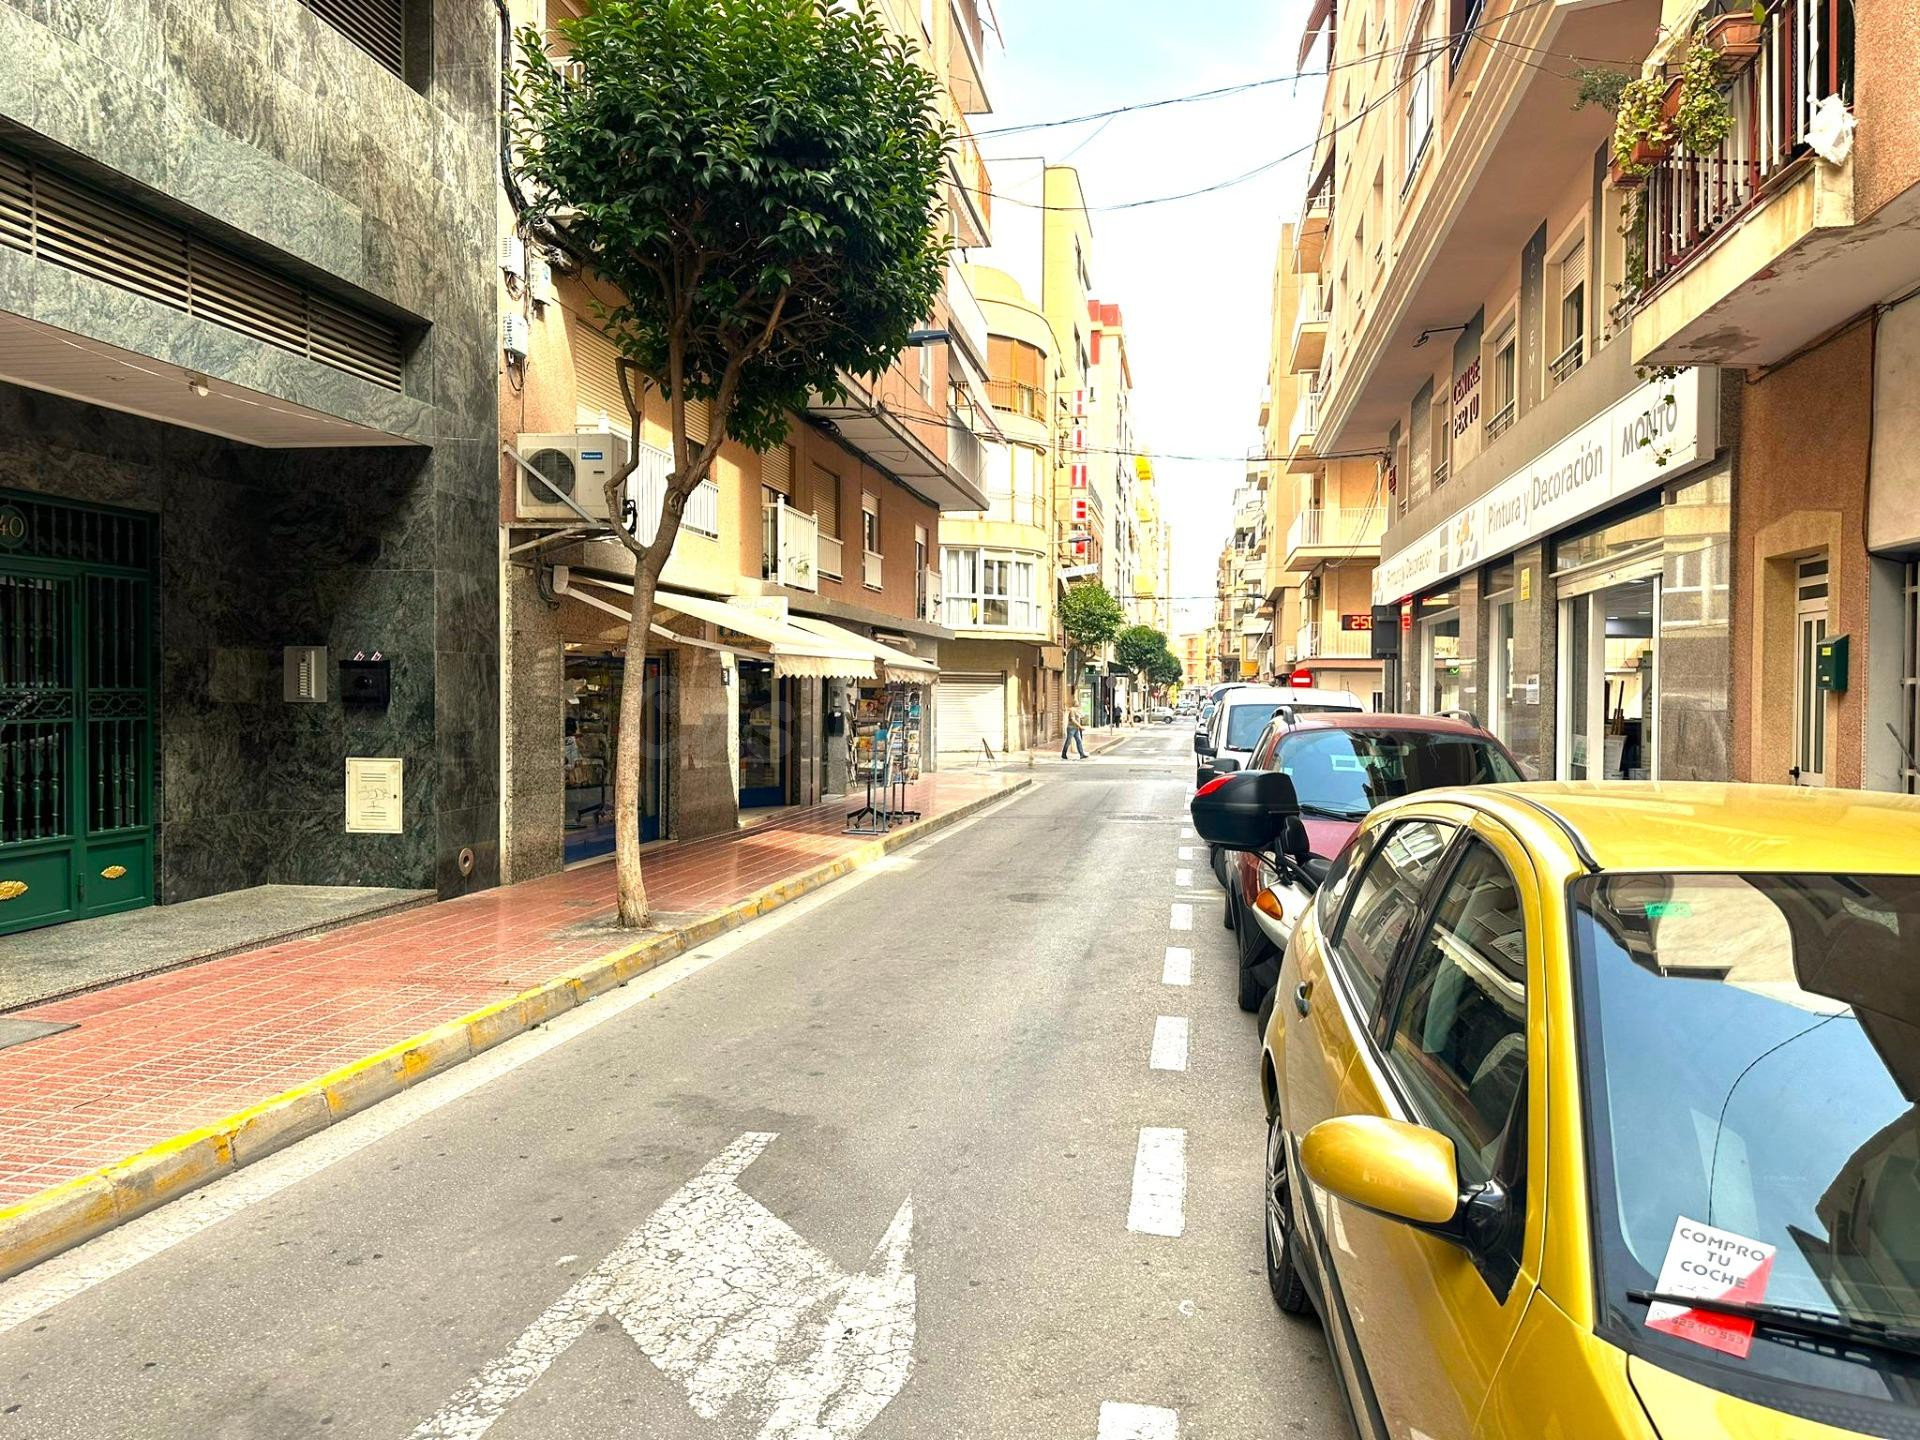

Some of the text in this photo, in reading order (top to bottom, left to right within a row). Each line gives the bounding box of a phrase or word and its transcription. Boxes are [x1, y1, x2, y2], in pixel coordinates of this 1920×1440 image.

[1528, 241, 1536, 408] ACADEMIA
[1488, 495, 1521, 535] Pintura
[1521, 489, 1530, 526] y
[1533, 440, 1604, 511] Decoración
[1680, 1228, 1765, 1262] COMPRO
[1707, 1251, 1731, 1267] TU
[1681, 1261, 1748, 1288] COCHE
